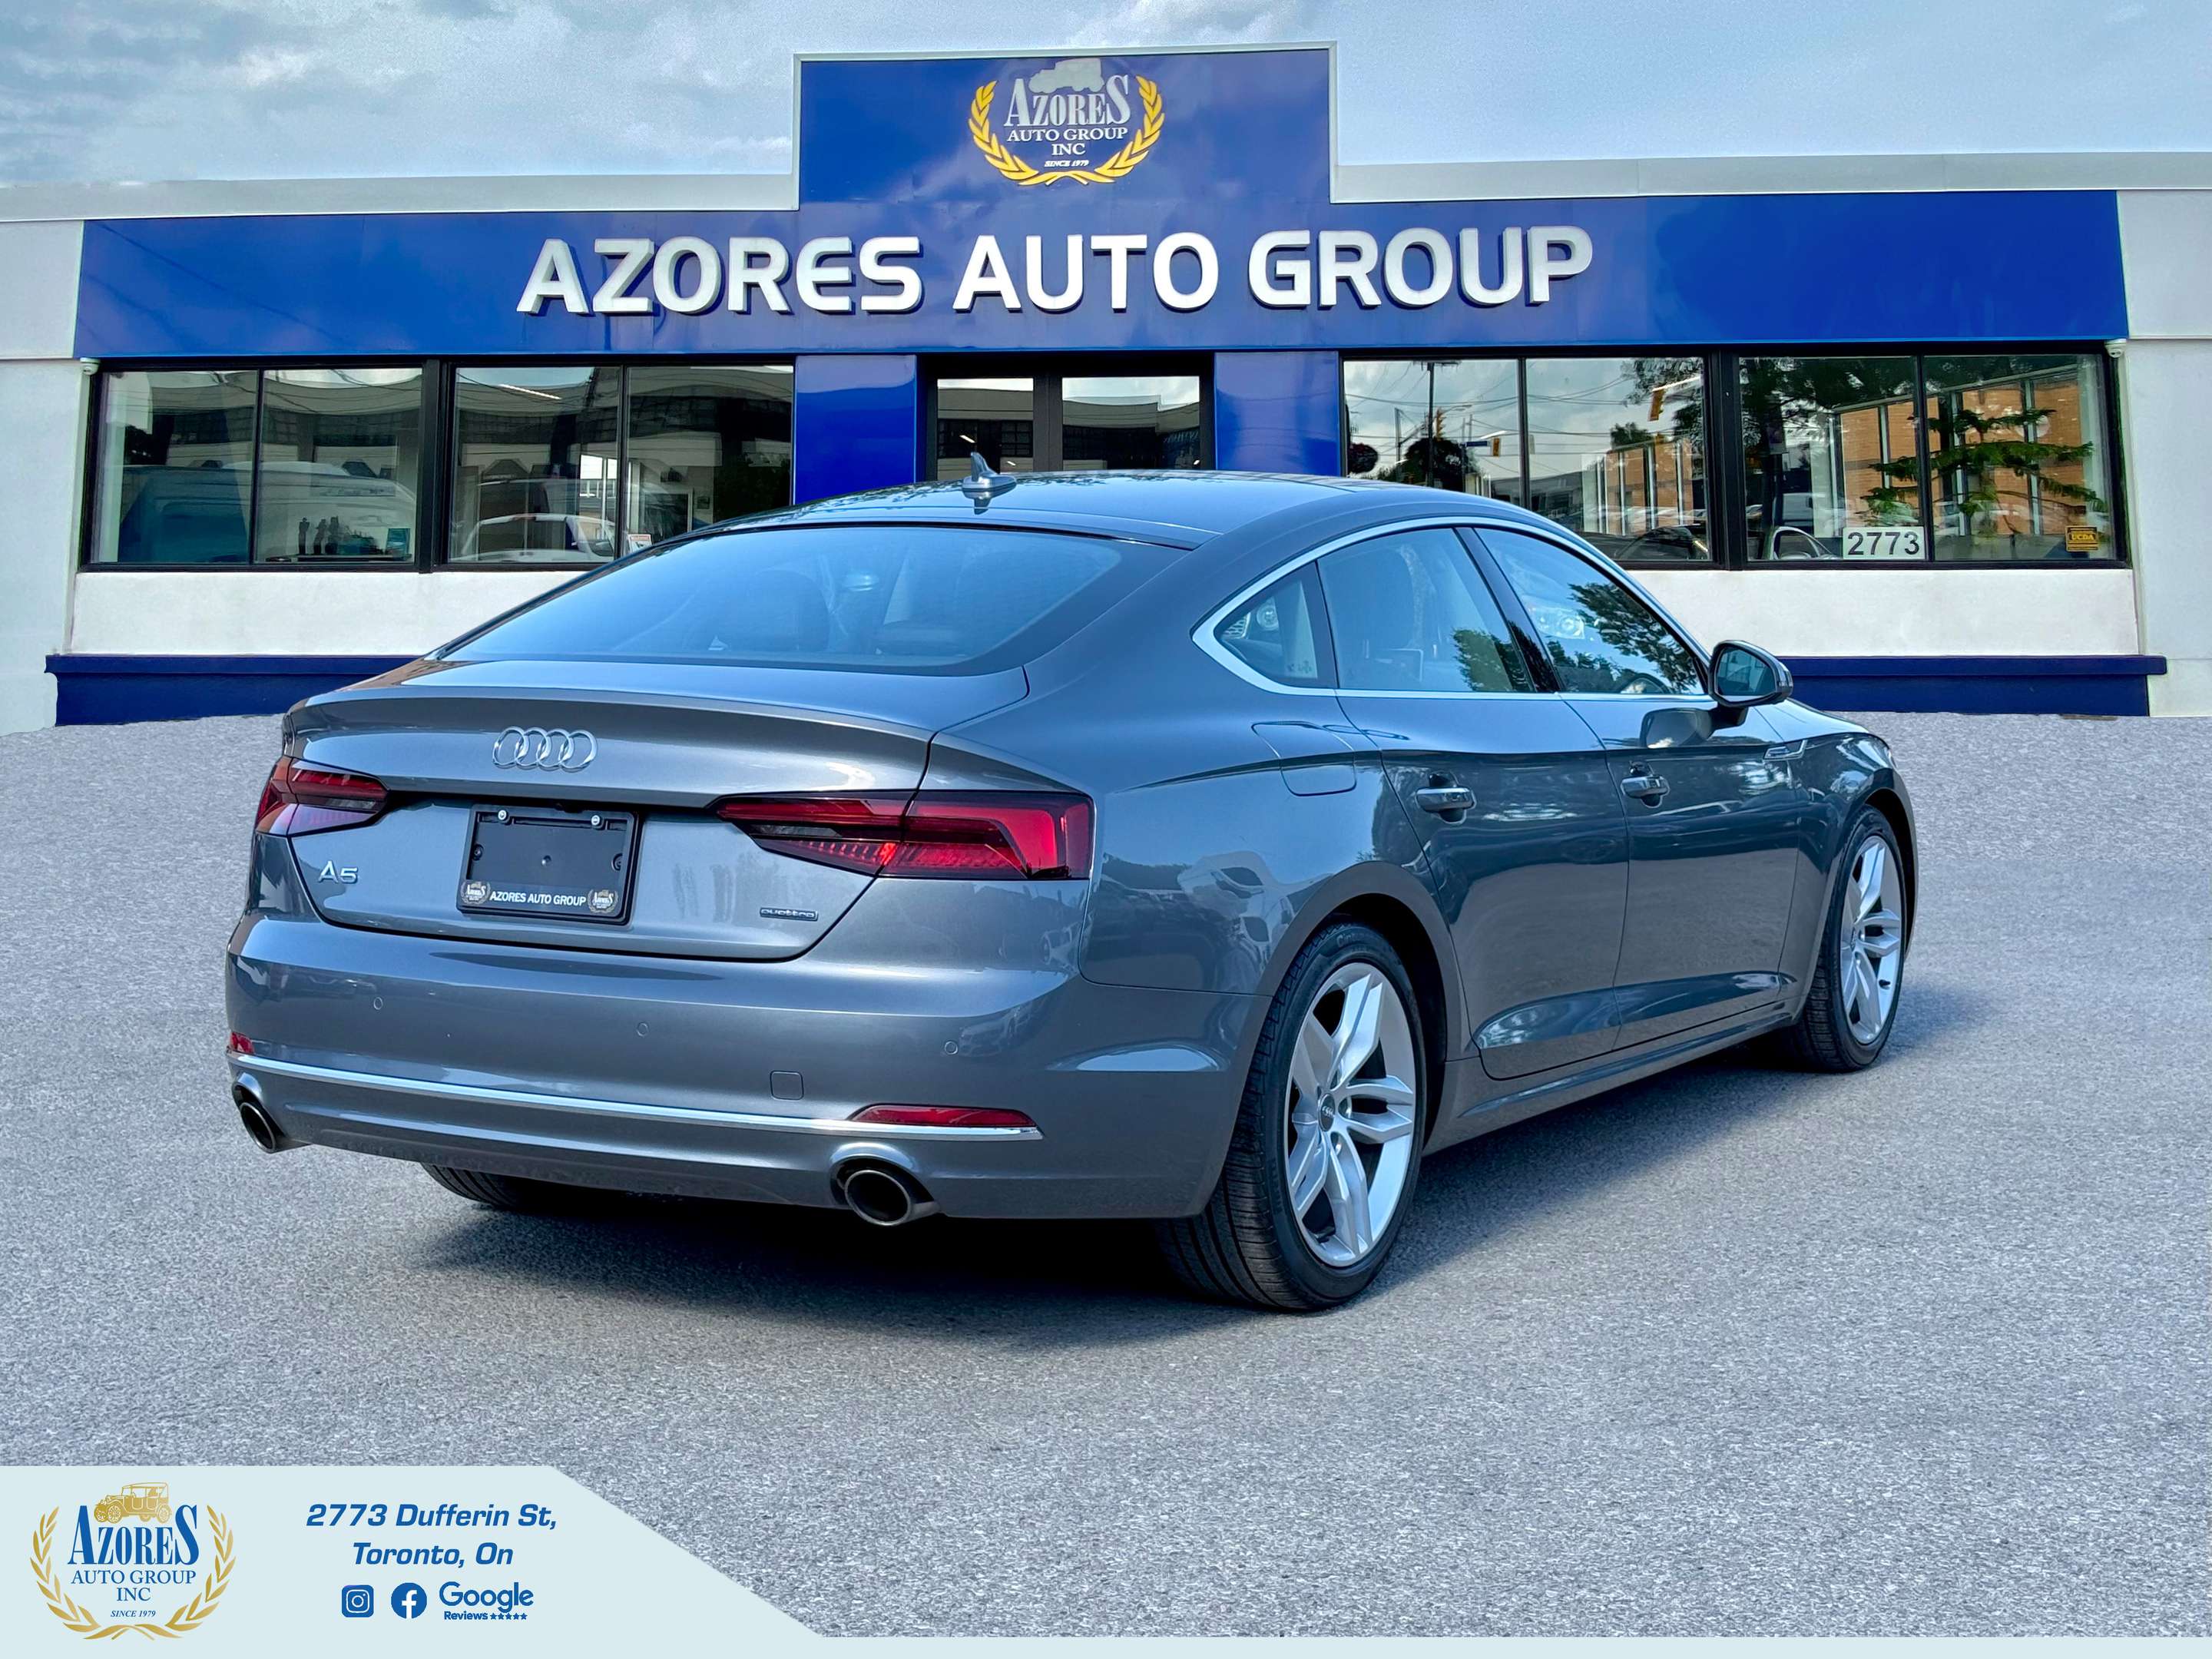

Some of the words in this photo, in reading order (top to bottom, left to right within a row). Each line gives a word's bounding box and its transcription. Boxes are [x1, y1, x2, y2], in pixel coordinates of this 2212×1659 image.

[1003, 75, 1131, 127] AZORES
[1006, 128, 1060, 142] AUTO
[1063, 127, 1128, 141] GROUP
[1051, 143, 1086, 156] INC
[516, 236, 924, 315] AZORES
[952, 231, 1219, 313] AUTO
[1247, 226, 1594, 309] GROUP
[1847, 531, 1920, 555] 2773
[317, 860, 359, 884] A5
[489, 891, 526, 902] AZORES
[527, 893, 552, 904] AUTO
[553, 895, 586, 906] GROUP
[760, 909, 815, 918] quattro
